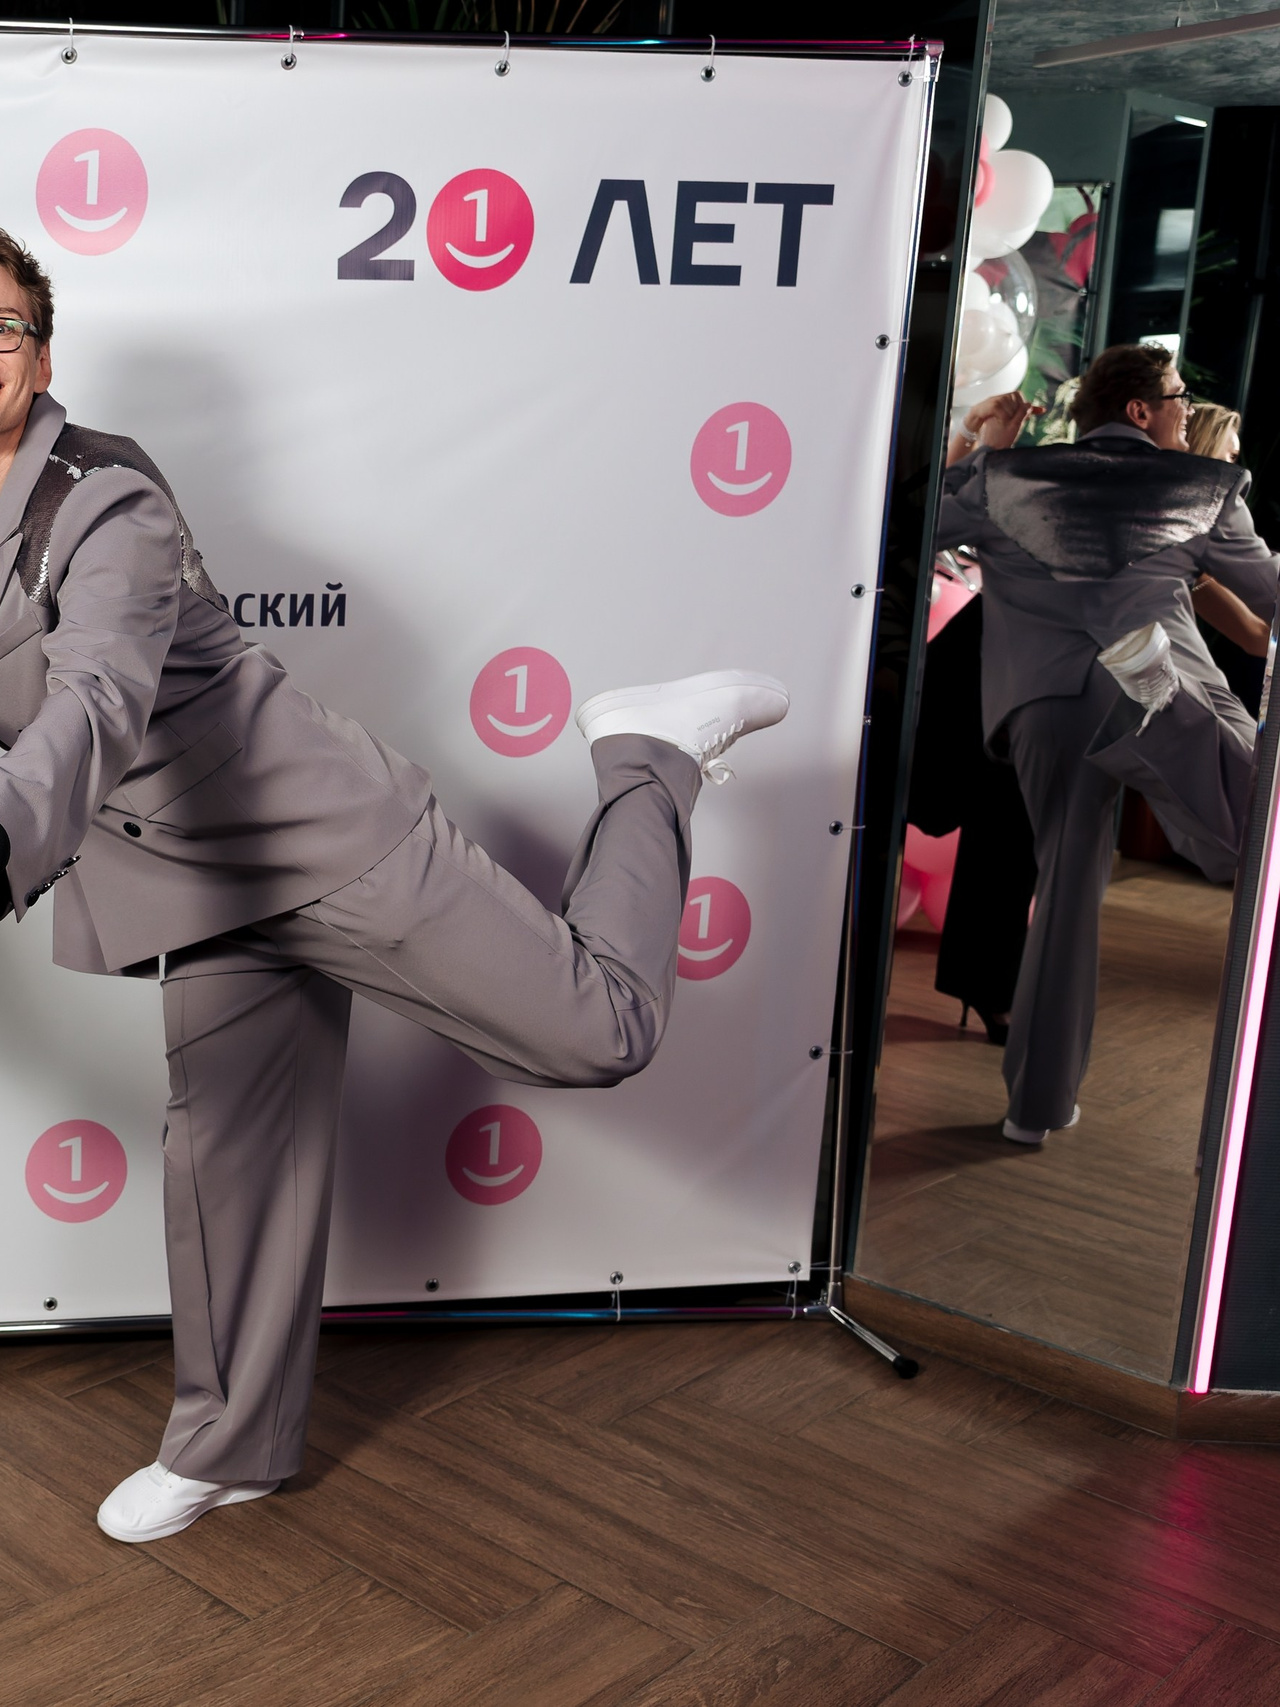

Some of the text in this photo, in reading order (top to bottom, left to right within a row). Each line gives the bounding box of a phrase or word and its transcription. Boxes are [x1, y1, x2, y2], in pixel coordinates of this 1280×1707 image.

[74, 150, 100, 205] 1
[570, 179, 835, 287] ЛЕТ
[726, 421, 749, 470] 1
[219, 582, 347, 627] ский
[504, 665, 529, 713] 1
[689, 893, 711, 939] 1
[58, 1136, 82, 1181] 1
[478, 1122, 501, 1165] 1
